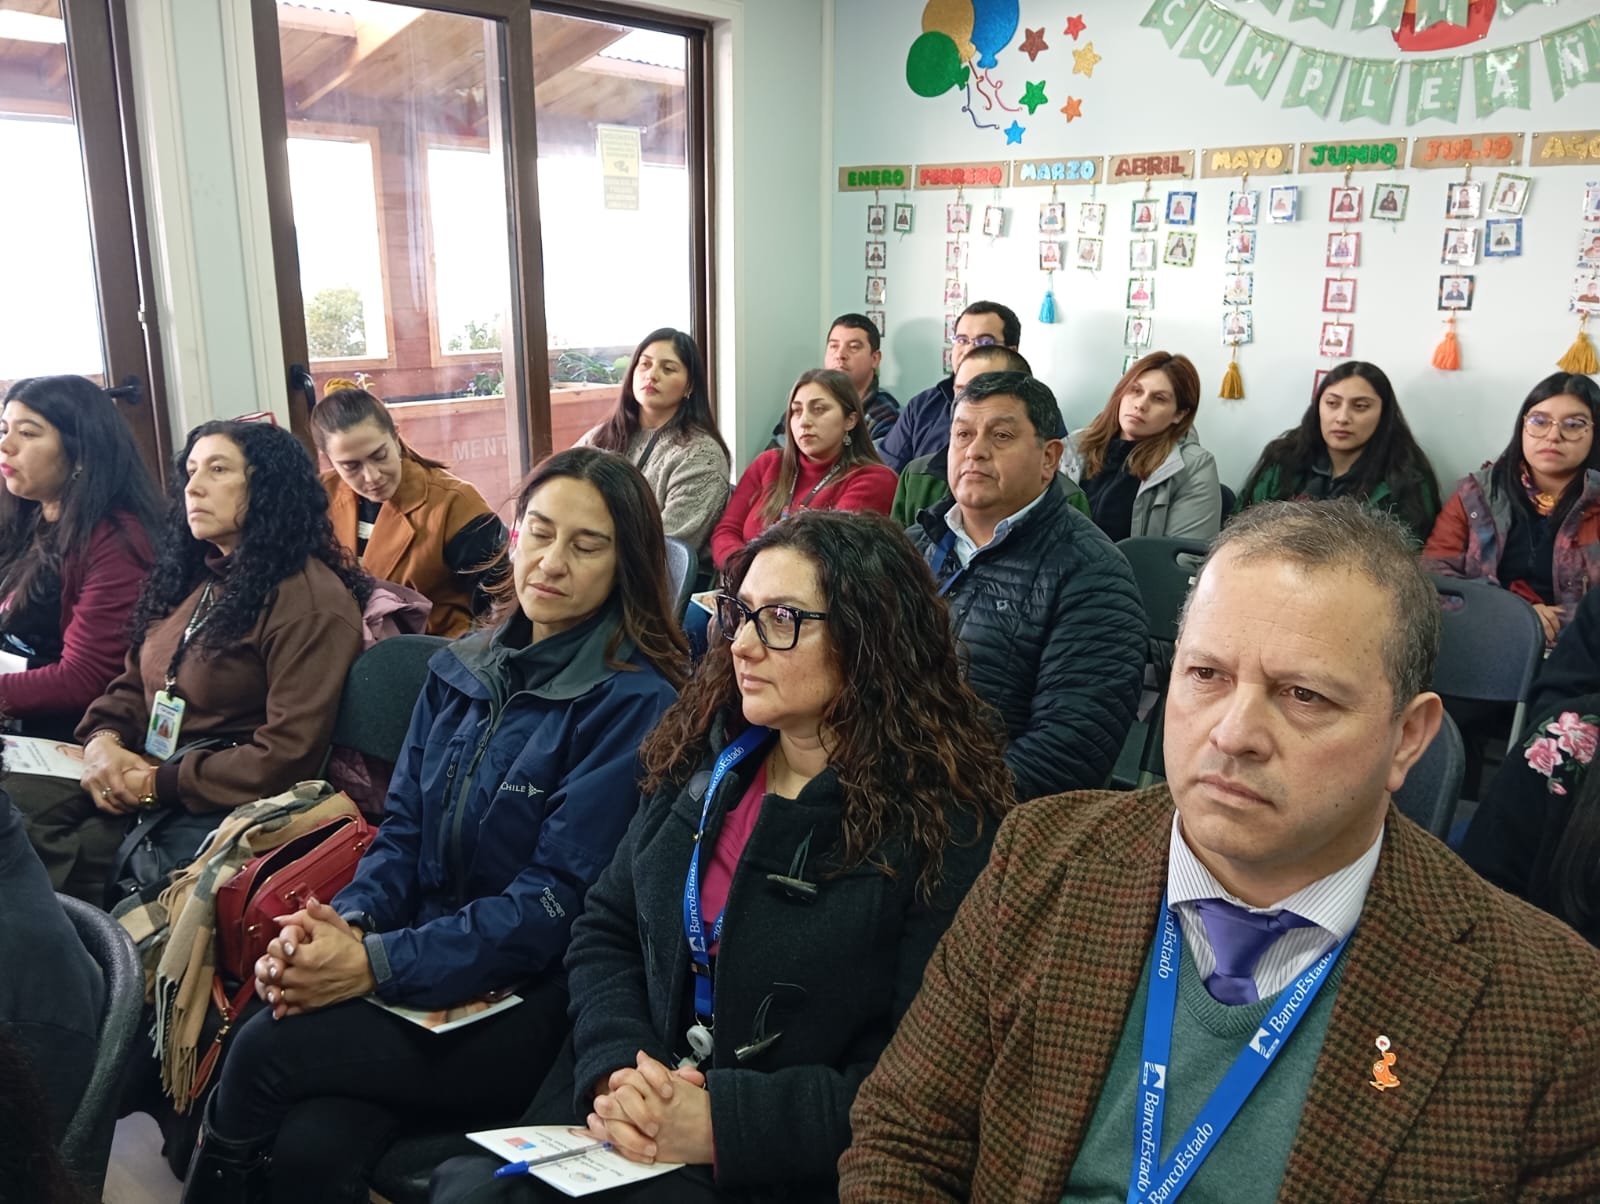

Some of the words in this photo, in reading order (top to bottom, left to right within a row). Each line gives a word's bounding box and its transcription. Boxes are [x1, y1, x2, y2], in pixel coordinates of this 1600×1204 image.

[1211, 147, 1283, 171] MAYO
[1309, 143, 1398, 166] JUNIO
[1423, 136, 1514, 162] JULIO
[847, 168, 905, 187] ENERO
[920, 166, 1003, 186] FEBRERO
[1020, 160, 1096, 181] MARZO
[1115, 155, 1185, 177] ABRIL
[500, 782, 526, 793] CHILE
[689, 862, 701, 934] BancoEstado
[1268, 951, 1333, 1034] BancoEstado
[1136, 1090, 1160, 1193] BancoEstado
[1147, 1122, 1214, 1204] BancoEstado
